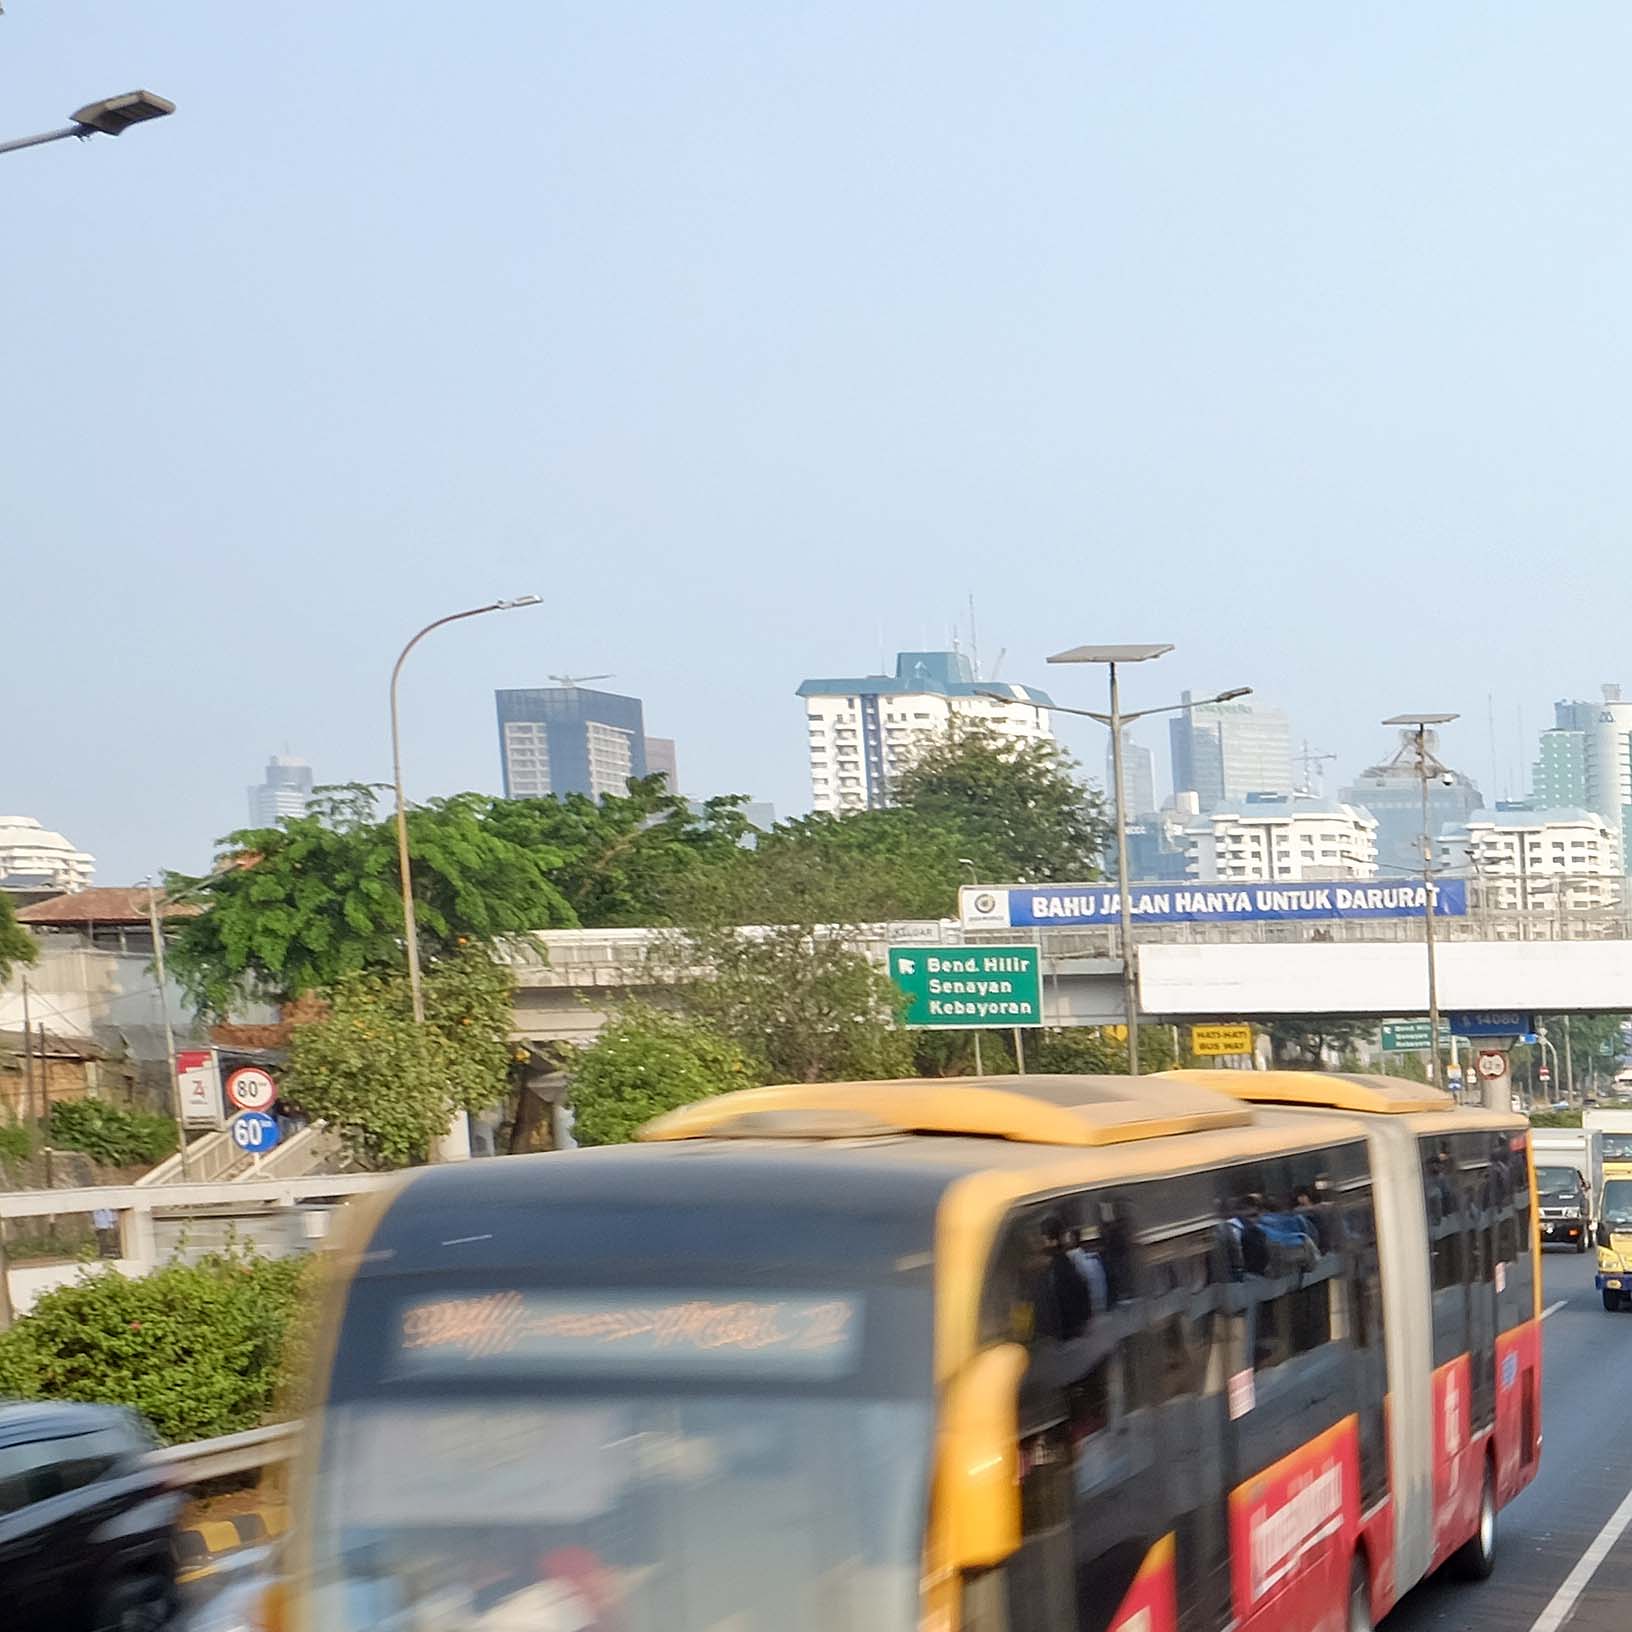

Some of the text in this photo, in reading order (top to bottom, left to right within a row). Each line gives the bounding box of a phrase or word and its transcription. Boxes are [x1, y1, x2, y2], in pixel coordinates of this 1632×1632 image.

[1033, 886, 1440, 918] BAHU JALAN HANYA UNTUK DARURAT
[927, 957, 1030, 972] Bend. Hilir
[929, 979, 1012, 995] Senayan
[929, 1001, 1032, 1016] Kebayoran
[238, 1080, 258, 1098] 80
[234, 1118, 262, 1146] 60
